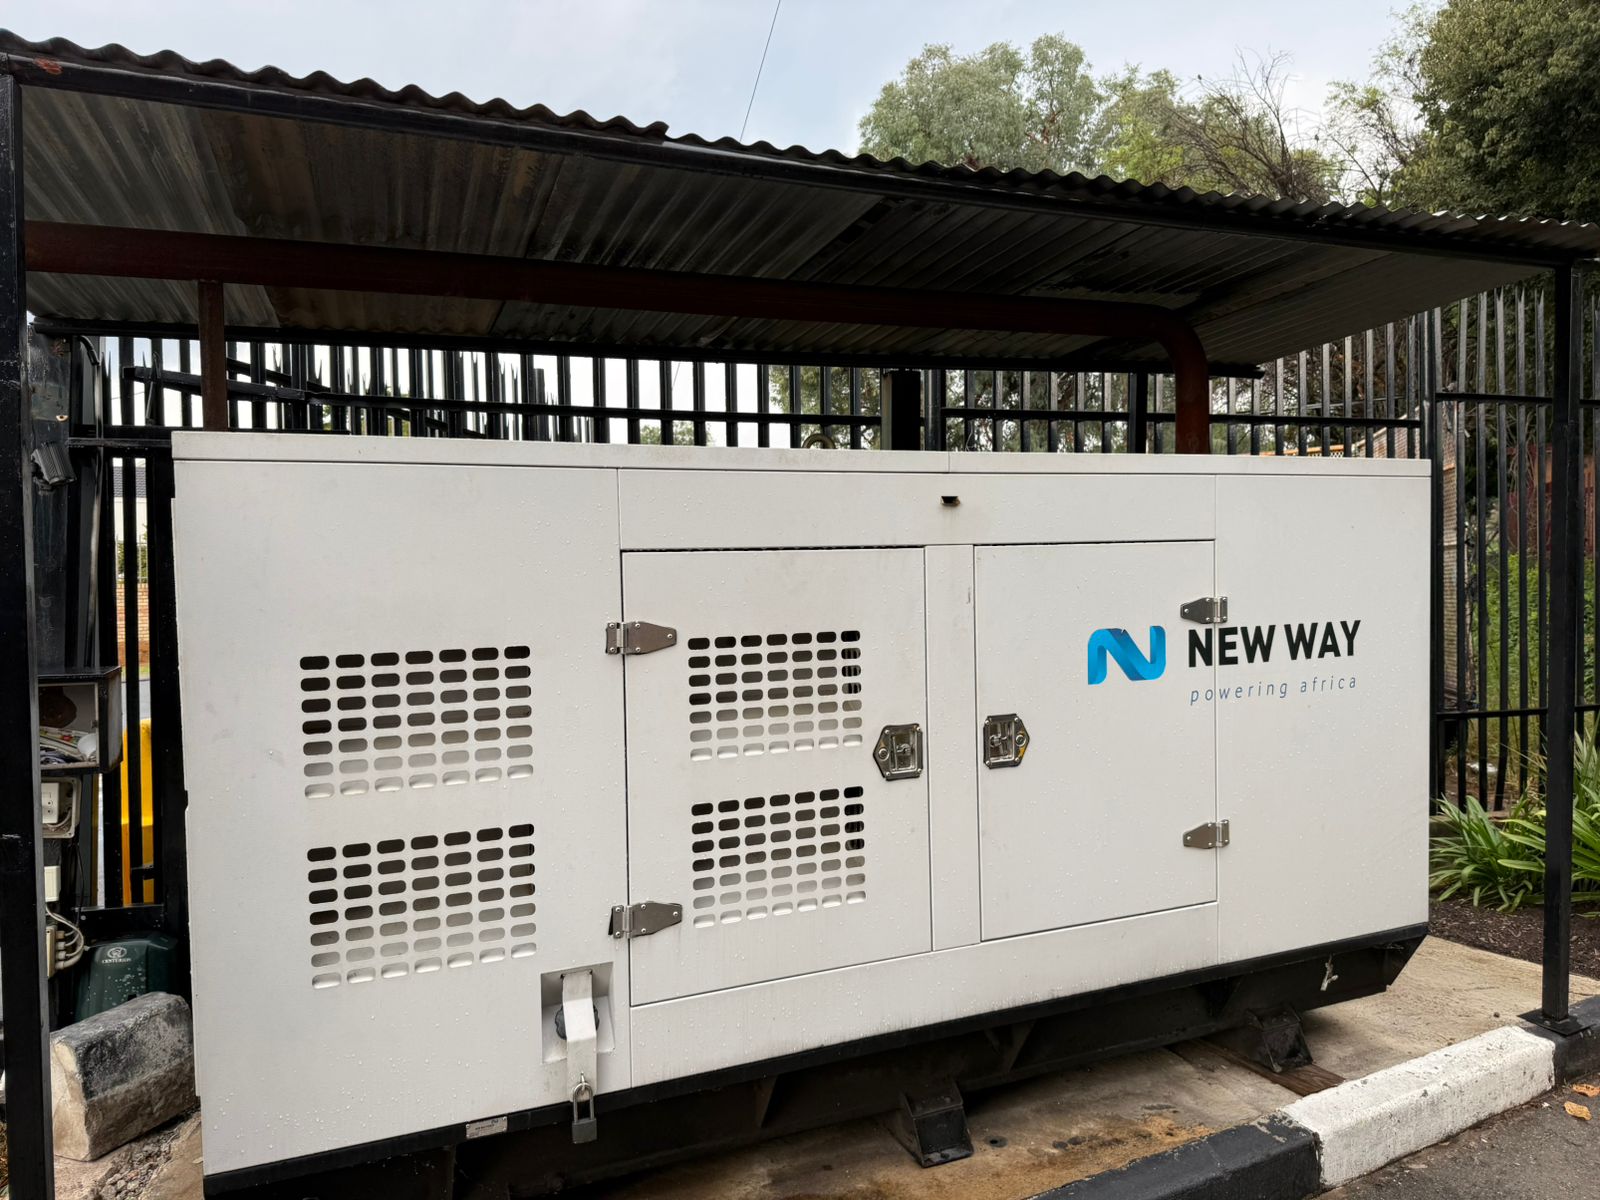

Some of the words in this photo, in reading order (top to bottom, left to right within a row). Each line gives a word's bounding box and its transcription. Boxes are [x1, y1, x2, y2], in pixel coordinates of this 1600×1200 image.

[1188, 624, 1276, 668] NEW
[1284, 620, 1361, 661] WAY
[1190, 681, 1289, 706] powering
[1300, 675, 1357, 693] africa
